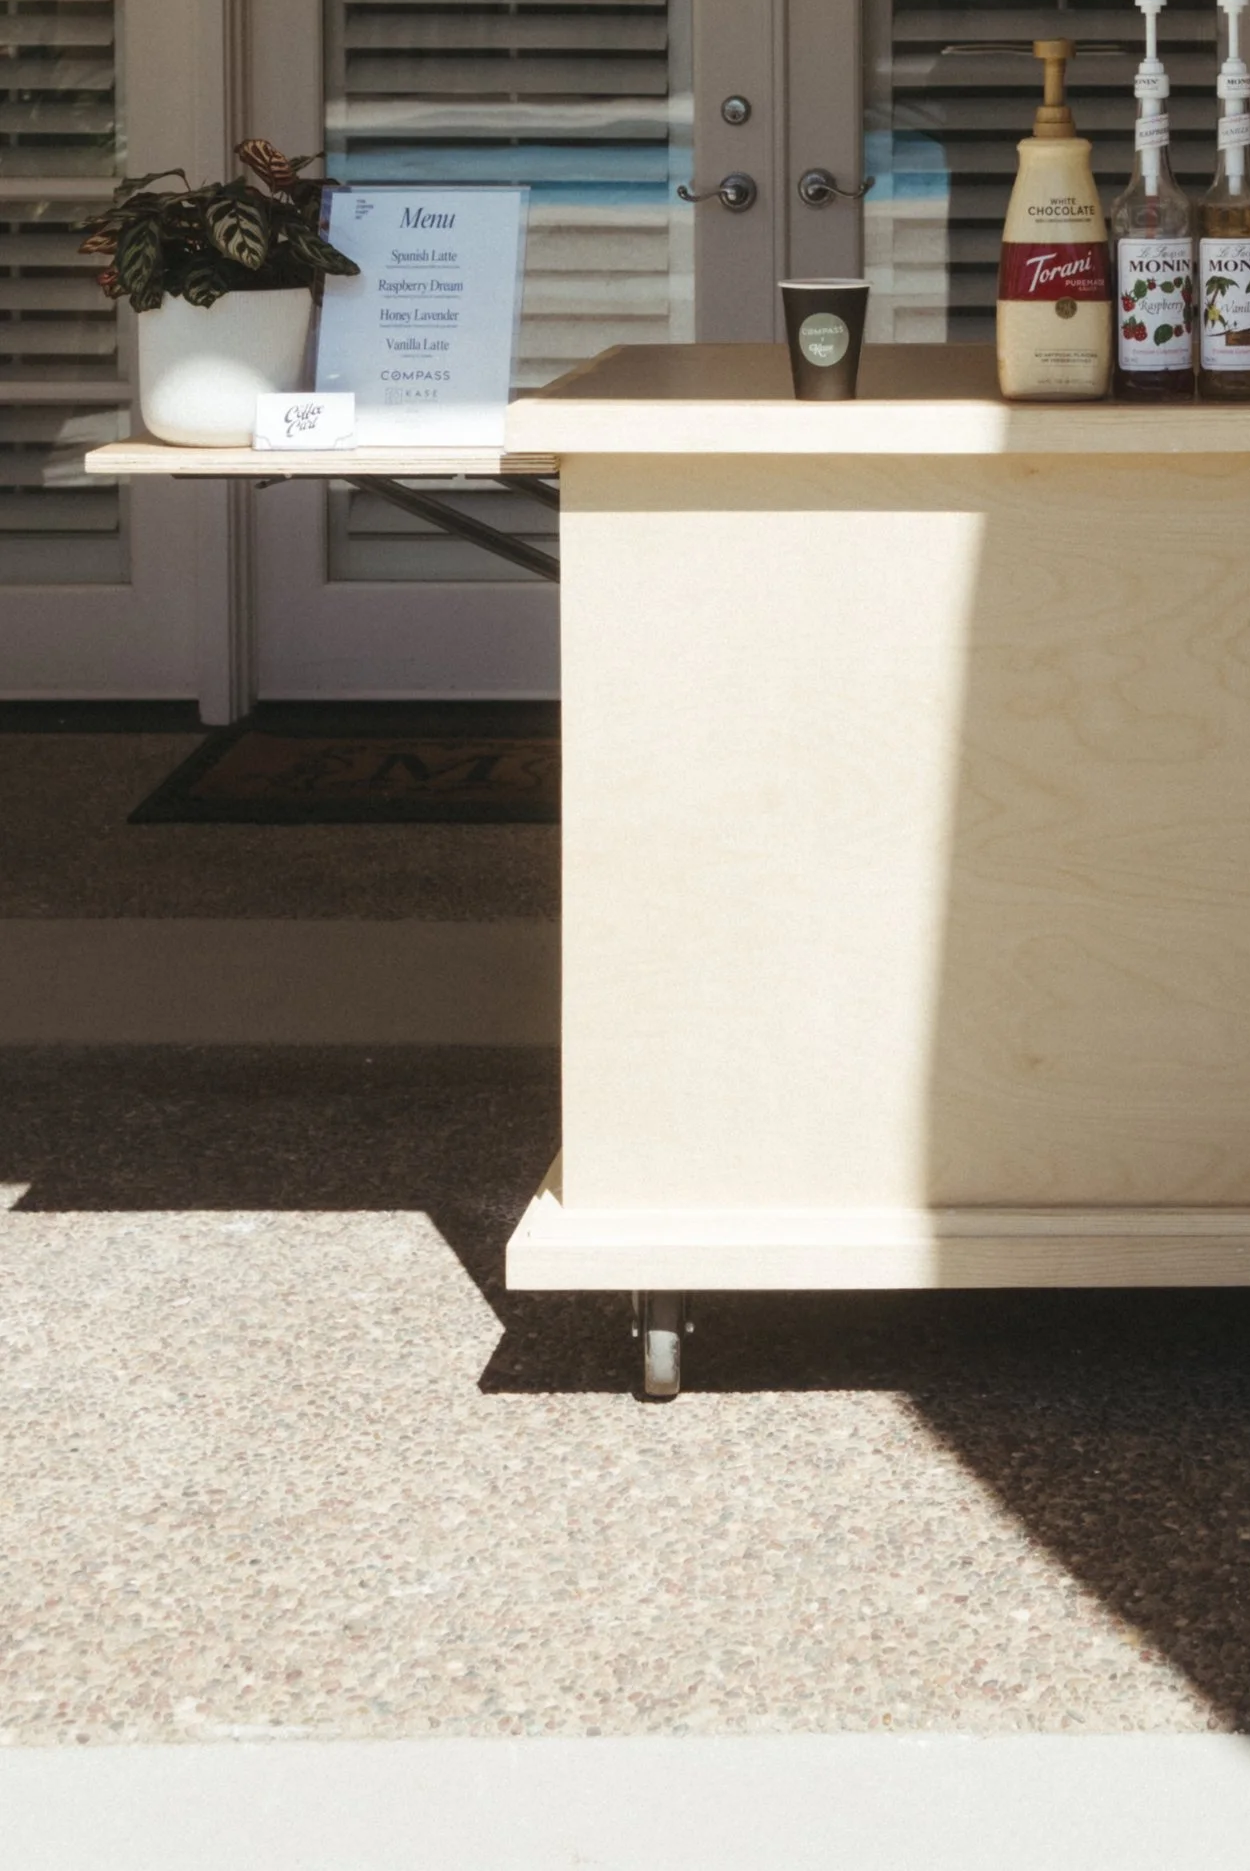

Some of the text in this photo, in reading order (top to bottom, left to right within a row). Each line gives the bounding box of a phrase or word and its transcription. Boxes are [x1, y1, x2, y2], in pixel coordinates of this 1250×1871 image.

[1050, 197, 1077, 206] WHITE
[399, 206, 456, 229] Menu
[1027, 206, 1096, 217] CHOCOLATE
[391, 249, 458, 264] Spanish Latte
[1025, 250, 1093, 293] Torani
[1129, 259, 1191, 273] MONIN
[378, 279, 464, 295] Raspberry Dream
[1138, 298, 1184, 316] Raspberry
[380, 308, 459, 324] Honey Lavender
[385, 338, 450, 351] Vanilla Latte
[380, 370, 451, 381] COMPASS
